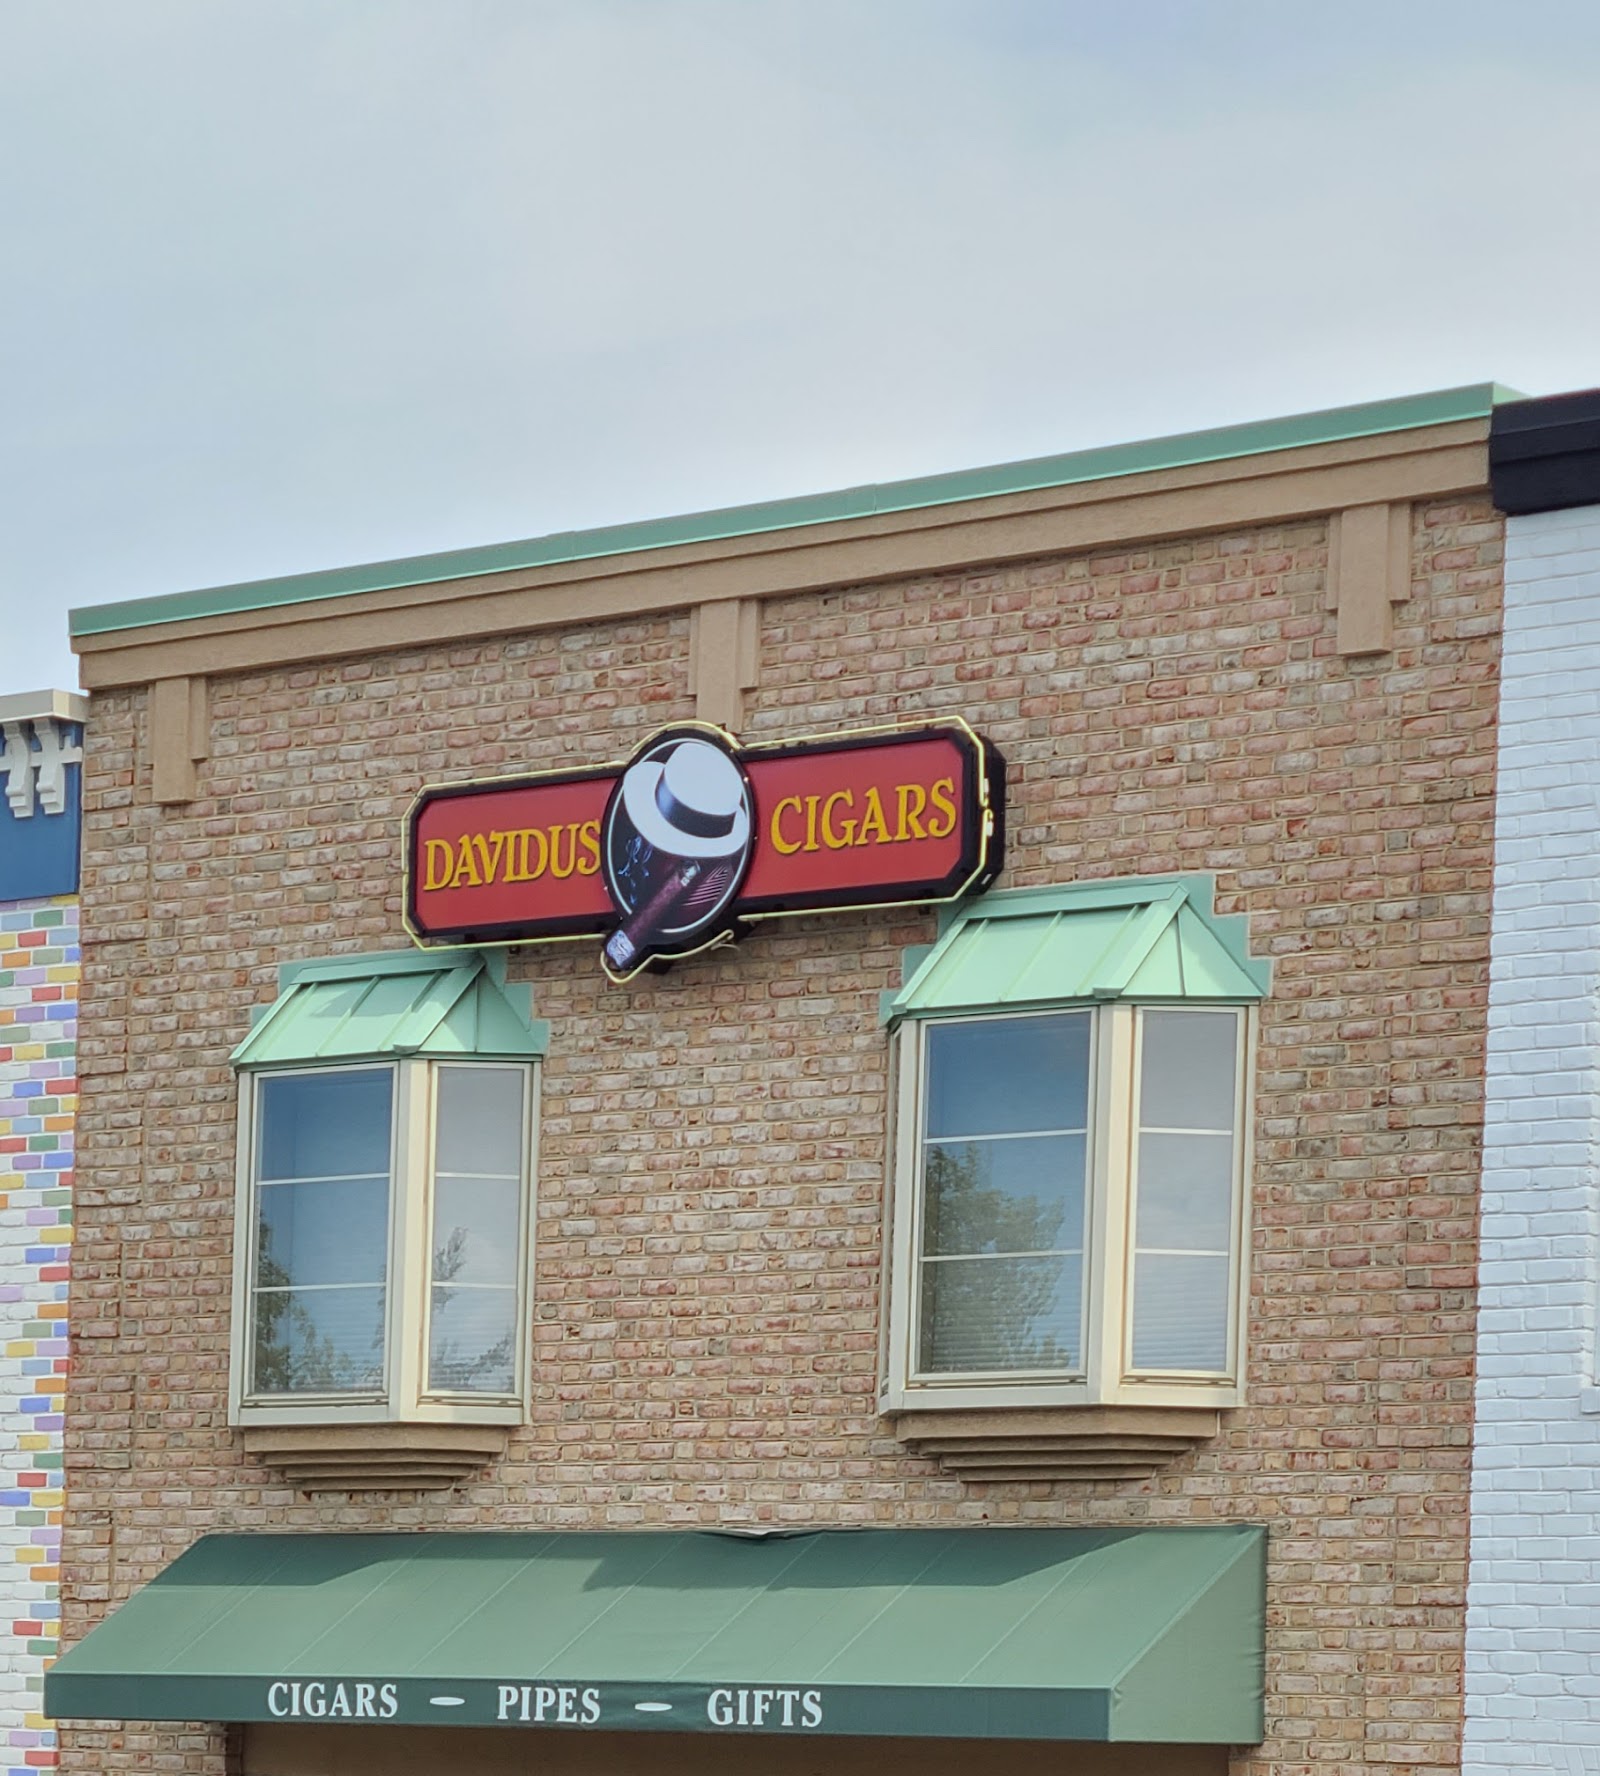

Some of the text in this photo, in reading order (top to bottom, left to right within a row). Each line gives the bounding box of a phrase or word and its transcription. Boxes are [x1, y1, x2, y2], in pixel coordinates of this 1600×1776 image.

[422, 776, 957, 892] DAVIDUS CIGARS
[267, 1682, 822, 1727] CIGARS PIPES GIFTS
